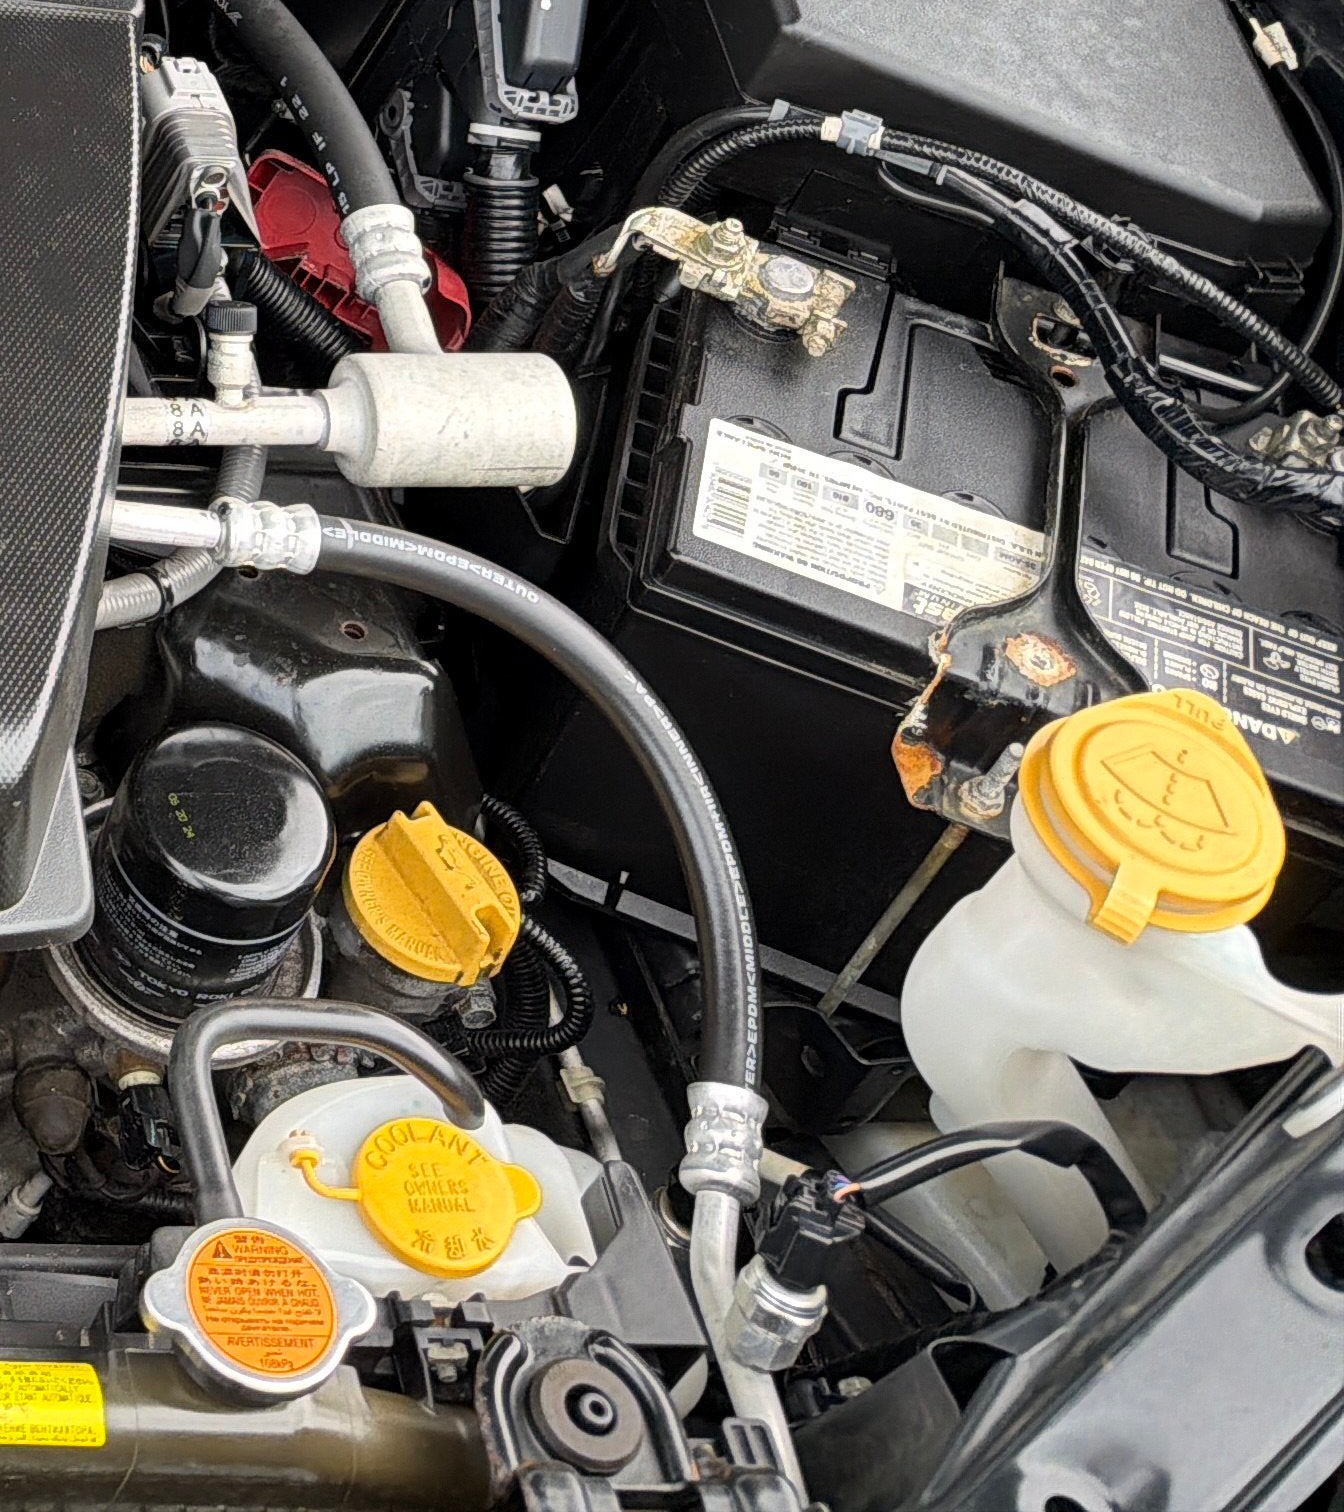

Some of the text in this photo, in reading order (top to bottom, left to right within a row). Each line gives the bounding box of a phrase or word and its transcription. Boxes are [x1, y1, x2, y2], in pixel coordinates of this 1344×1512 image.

[291, 93, 310, 121] 22
[325, 161, 341, 187] LP
[170, 402, 203, 417] 8 A
[172, 420, 205, 437] 8 A
[862, 500, 896, 522] 680
[453, 831, 507, 887] NGINE
[138, 969, 189, 997] TOKYO
[365, 1123, 488, 1169] COOLANT
[409, 1162, 443, 1178] SEE
[404, 1179, 469, 1196] OWNERS
[408, 1197, 475, 1213] MANUAL
[232, 1245, 289, 1255] WARNING
[227, 1337, 315, 1348] AVERTISSEMENT
